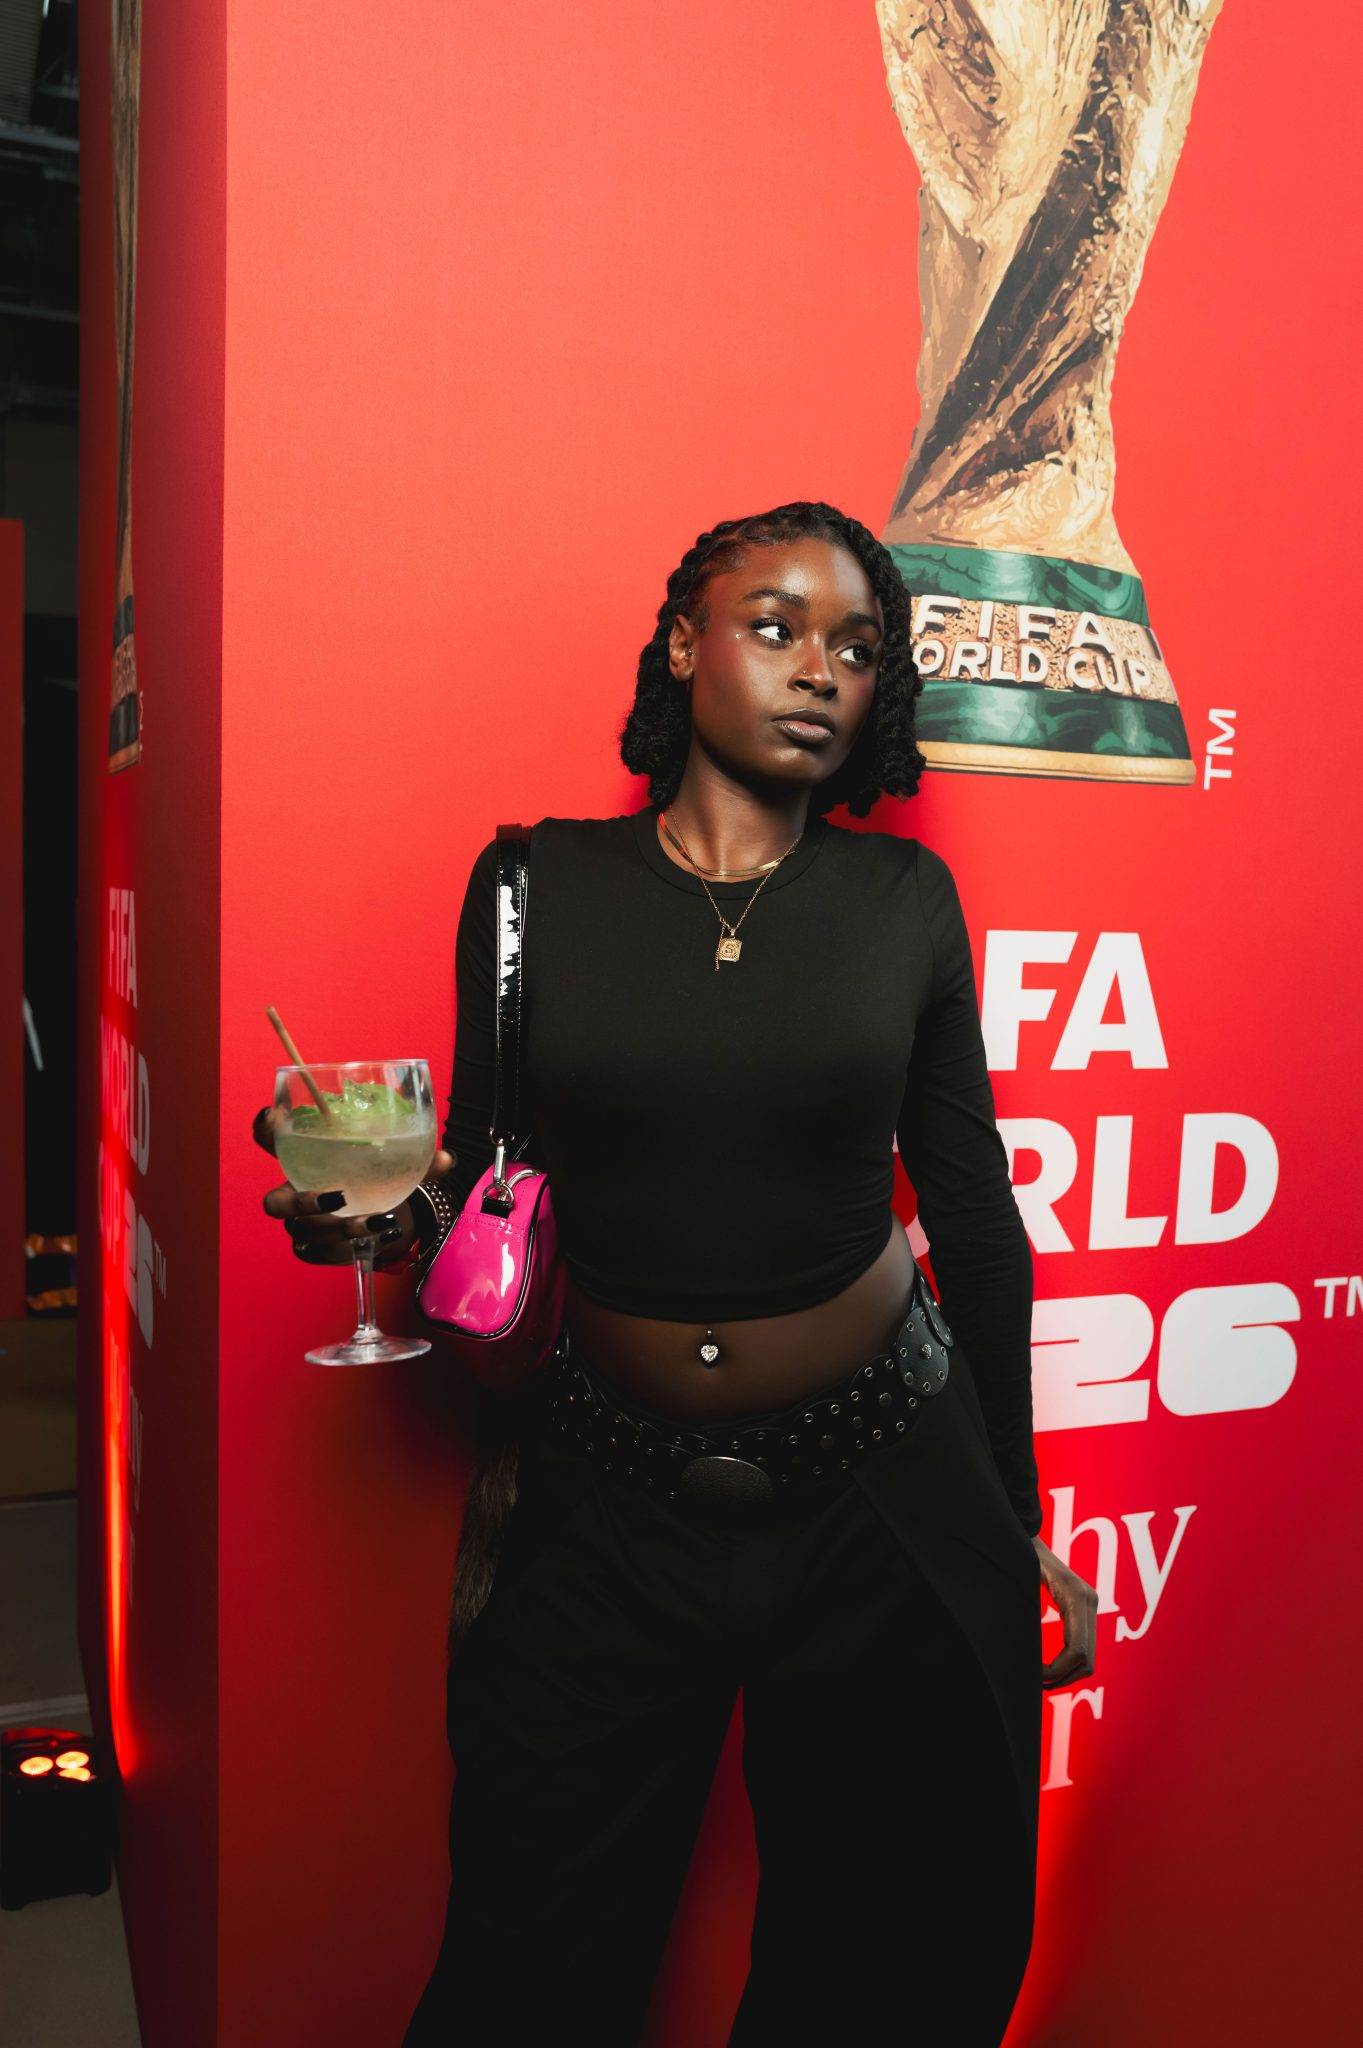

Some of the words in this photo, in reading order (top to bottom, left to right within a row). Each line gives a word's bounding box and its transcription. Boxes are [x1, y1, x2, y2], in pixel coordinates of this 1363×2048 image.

[912, 639, 1049, 683] ORLD
[1066, 648, 1152, 696] CUP
[913, 594, 1113, 652] FIFA
[1203, 708, 1237, 790] TM
[109, 887, 138, 1009] FIFA
[983, 929, 1169, 1071] FA
[101, 1013, 150, 1177] WORLD
[995, 1112, 1280, 1254] RLD
[123, 1187, 154, 1350] 26
[1031, 1282, 1302, 1433] 26
[1041, 1486, 1198, 1643] hy
